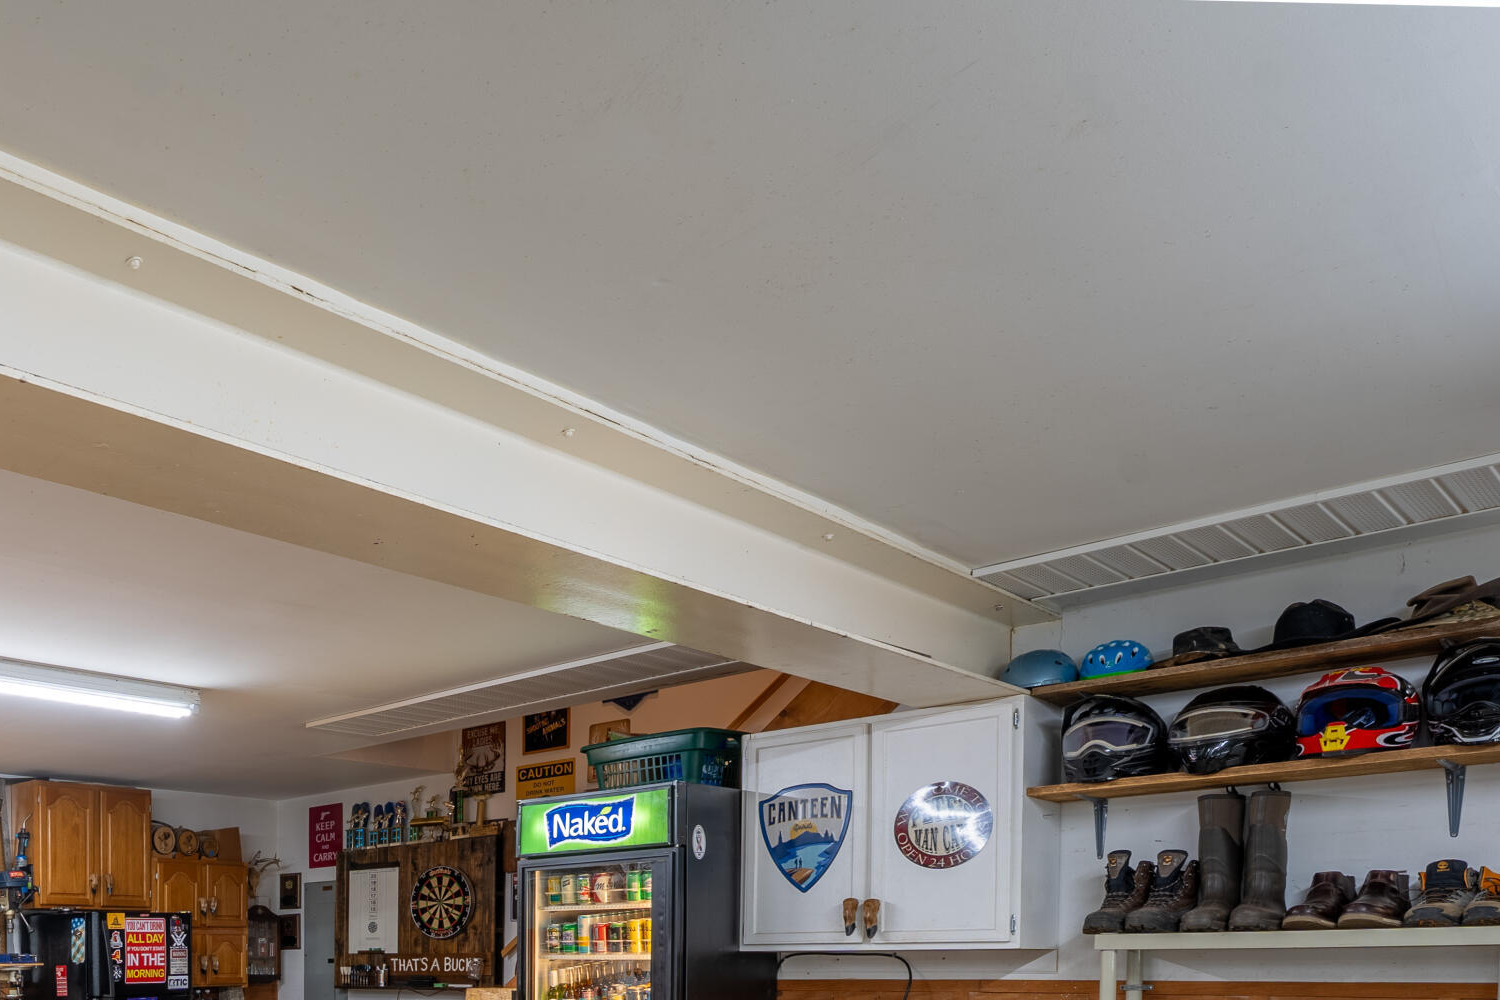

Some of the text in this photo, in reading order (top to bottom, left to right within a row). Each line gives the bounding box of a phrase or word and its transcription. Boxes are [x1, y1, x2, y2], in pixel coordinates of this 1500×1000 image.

[519, 763, 572, 780] CAUTION
[474, 775, 488, 784] EYES
[490, 773, 502, 782] ARE
[768, 796, 842, 826] CANTEEN
[316, 820, 335, 831] KEEP
[316, 832, 335, 843] CALM
[914, 827, 938, 852] MAN
[897, 832, 927, 864] OPEN
[928, 858, 945, 867] 24
[314, 851, 337, 862] CARRY
[126, 921, 164, 931] YOU CAN'T DRINK
[127, 934, 164, 943] ALL DAY
[127, 953, 164, 966] IN THE
[390, 957, 428, 972] THAT'S
[430, 958, 440, 971] A
[127, 969, 164, 978] MORNING
[169, 978, 187, 986] RTIC
